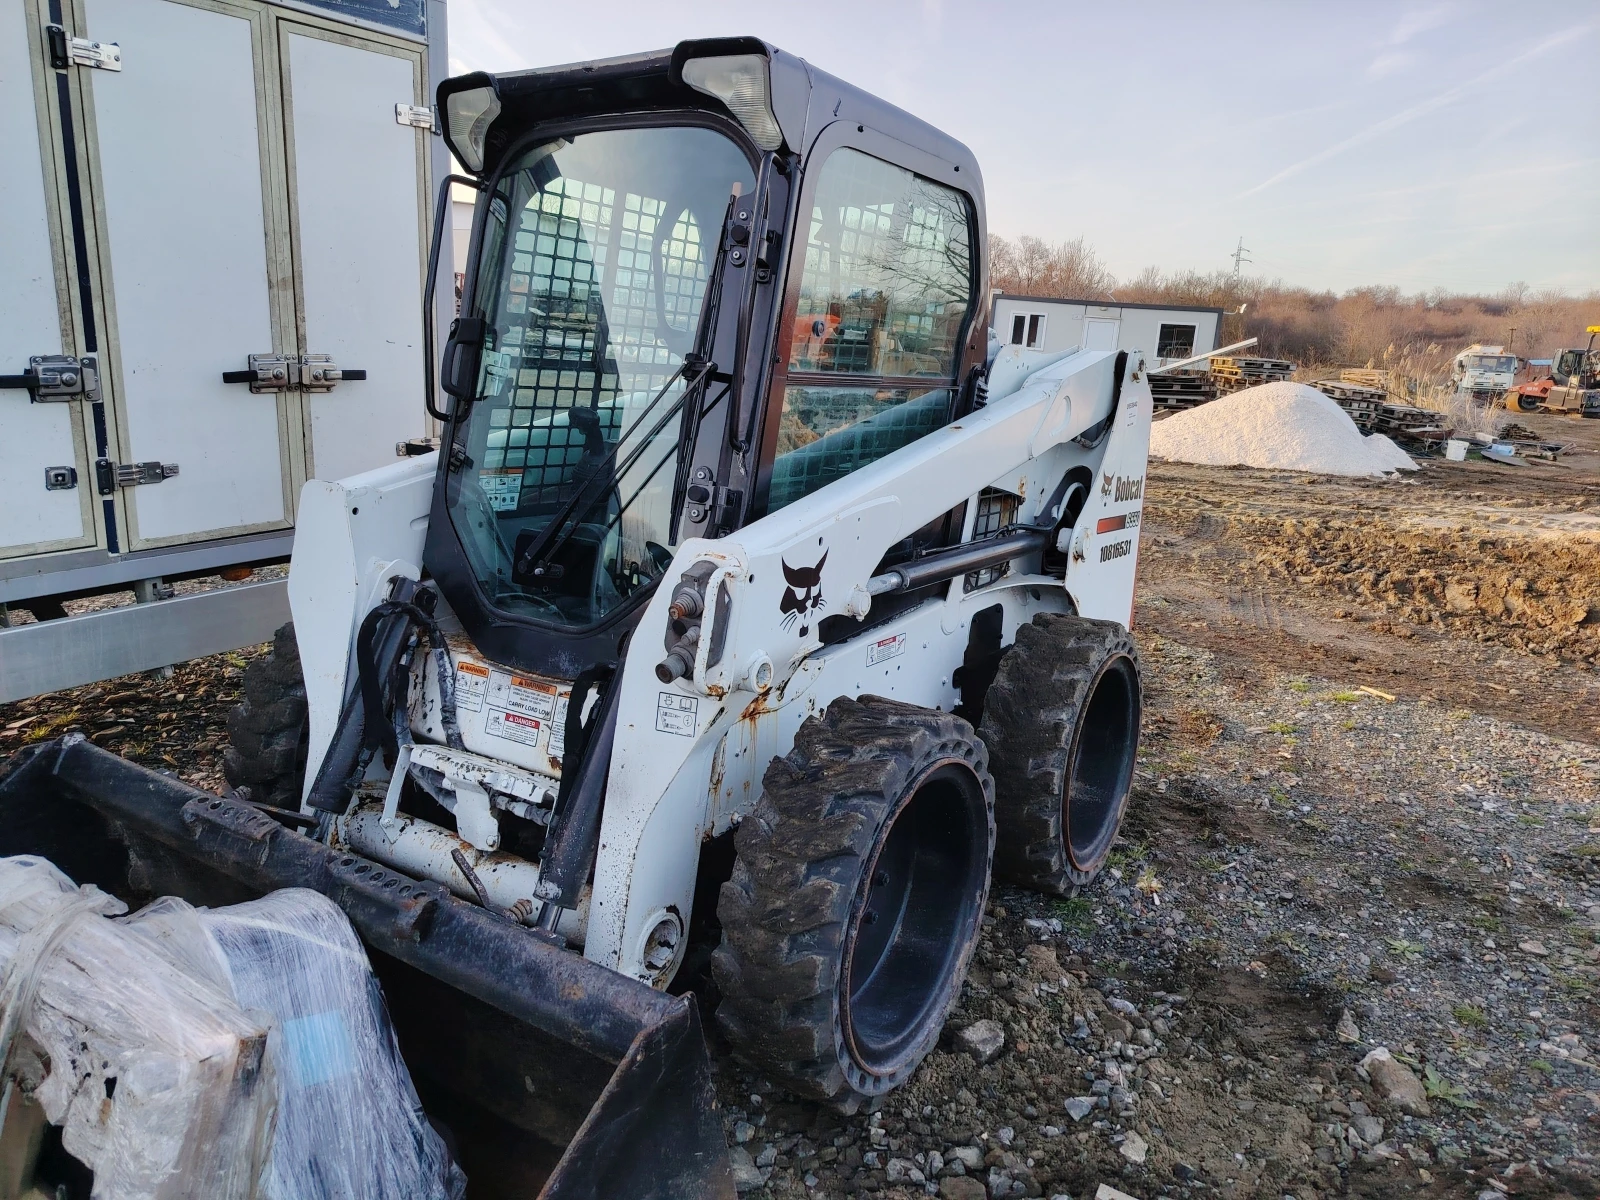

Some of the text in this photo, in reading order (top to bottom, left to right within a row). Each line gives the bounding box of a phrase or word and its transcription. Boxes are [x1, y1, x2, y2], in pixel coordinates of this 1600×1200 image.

[1114, 475, 1143, 502] Bobcat
[1100, 539, 1131, 563] 10816531
[464, 665, 487, 676] WARNING
[524, 681, 550, 693] WARNING
[508, 700, 551, 716] CARRY LOAD LOW
[514, 717, 536, 728] DANGER
